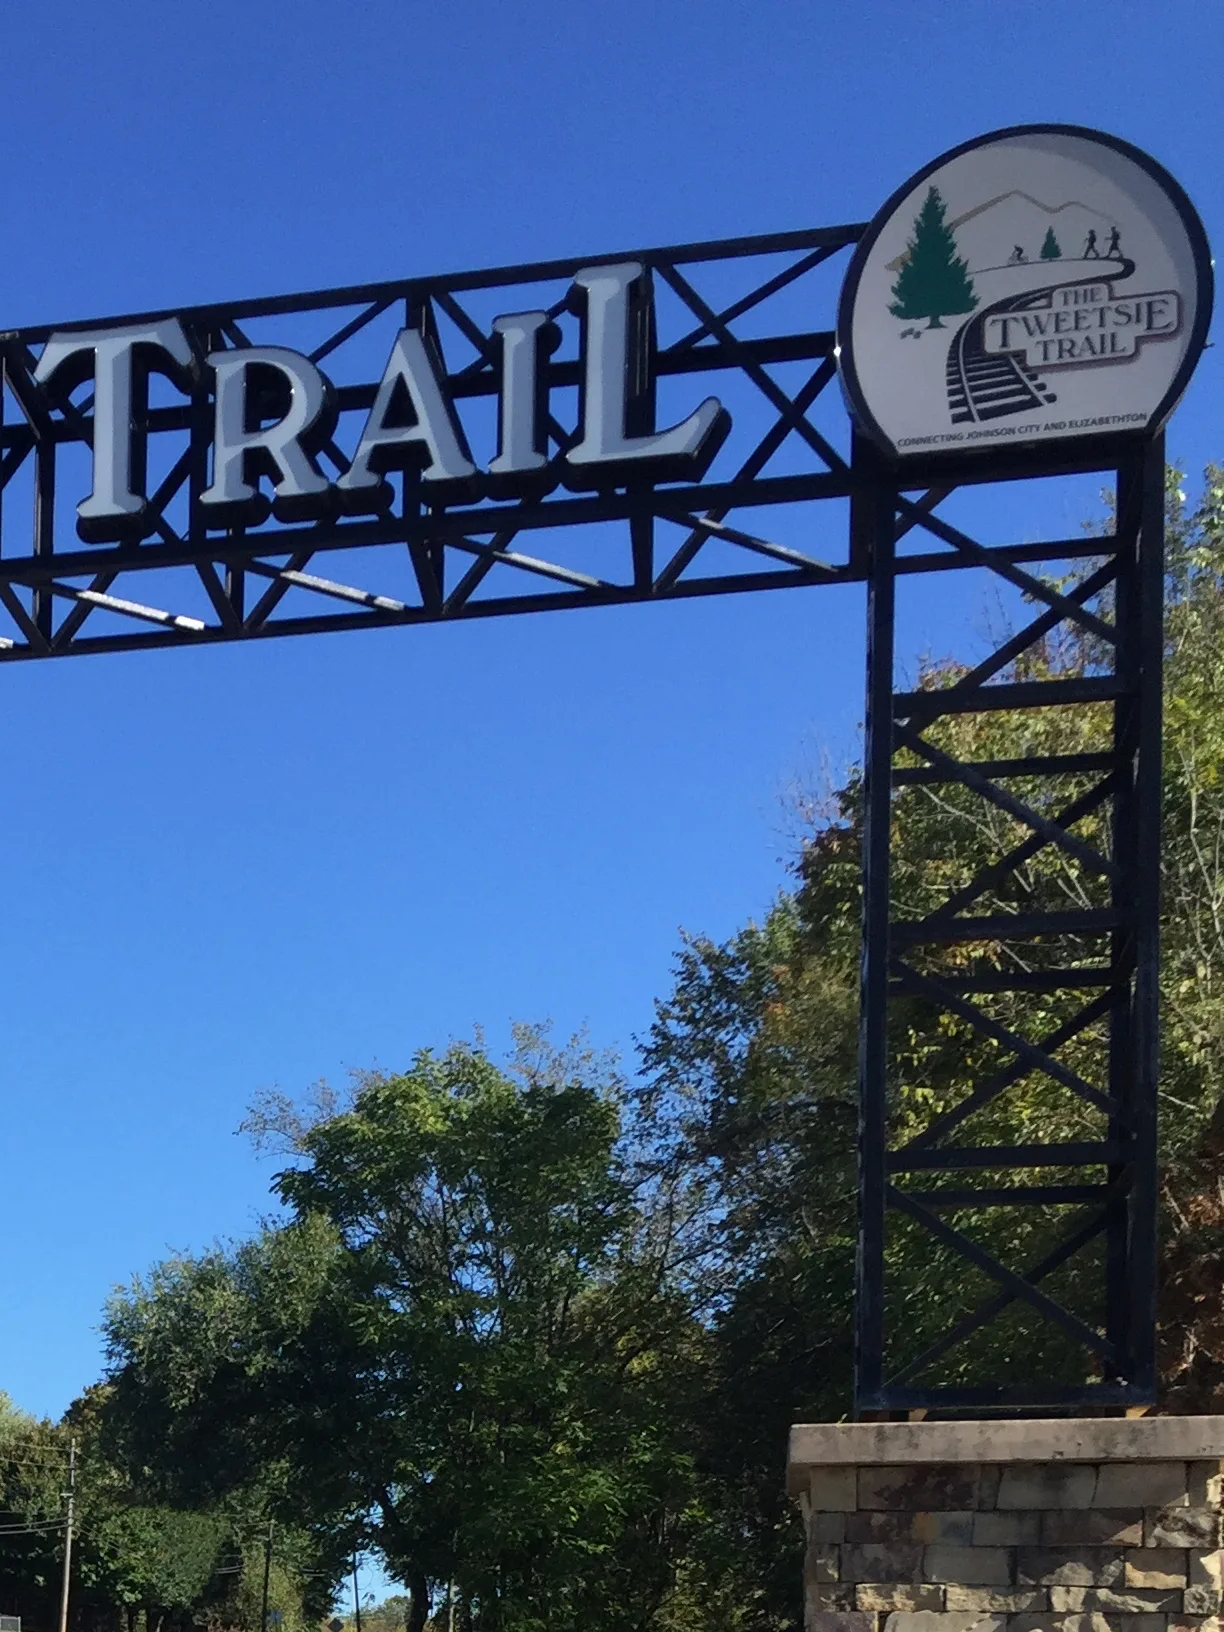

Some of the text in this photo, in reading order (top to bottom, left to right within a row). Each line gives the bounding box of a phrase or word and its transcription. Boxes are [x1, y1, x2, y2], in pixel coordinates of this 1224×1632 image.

[1059, 286, 1102, 306] THE
[989, 299, 1173, 349] TWEETSIE
[1035, 332, 1126, 362] TRAIL
[32, 261, 726, 524] TRAIL
[897, 411, 1148, 447] CONNECTING JOHNSON CITY AND ELIZABETHTON
